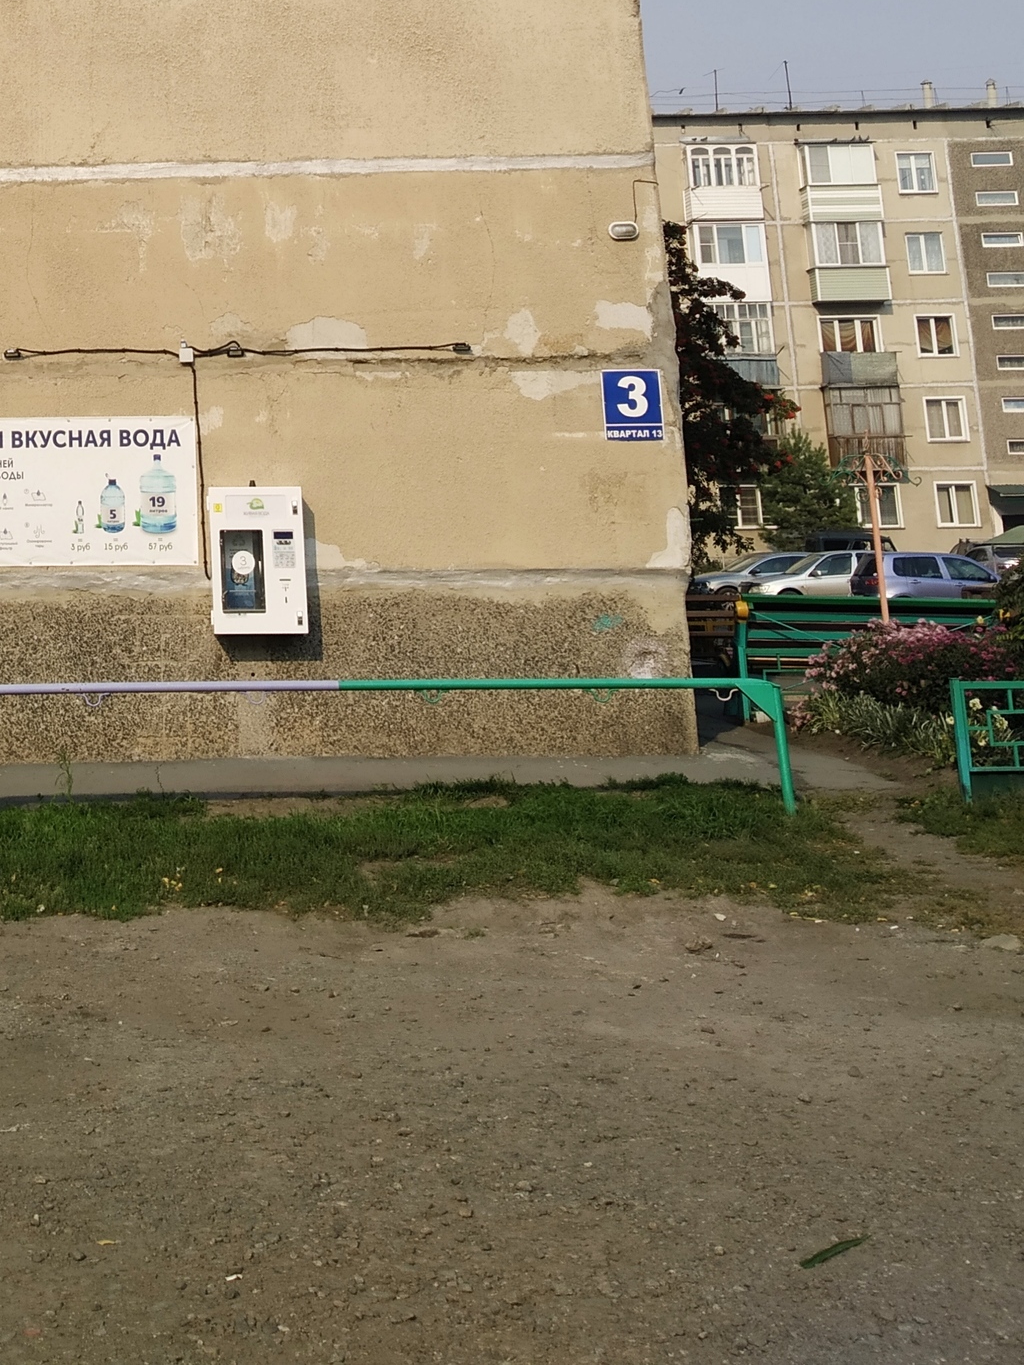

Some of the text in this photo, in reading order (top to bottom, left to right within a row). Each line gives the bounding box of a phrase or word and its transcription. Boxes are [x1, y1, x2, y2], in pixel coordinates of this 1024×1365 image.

[616, 375, 649, 418] 3
[11, 430, 112, 449] ВКУСНАЯ
[118, 428, 182, 450] ВОДА
[607, 430, 663, 438] КВАРТАЛ 13
[148, 496, 166, 508] 19
[109, 509, 117, 520] 5
[70, 543, 91, 552] 3 руб
[104, 542, 129, 552] 15 руб
[148, 542, 173, 552] 57 руб
[239, 555, 248, 566] 3
